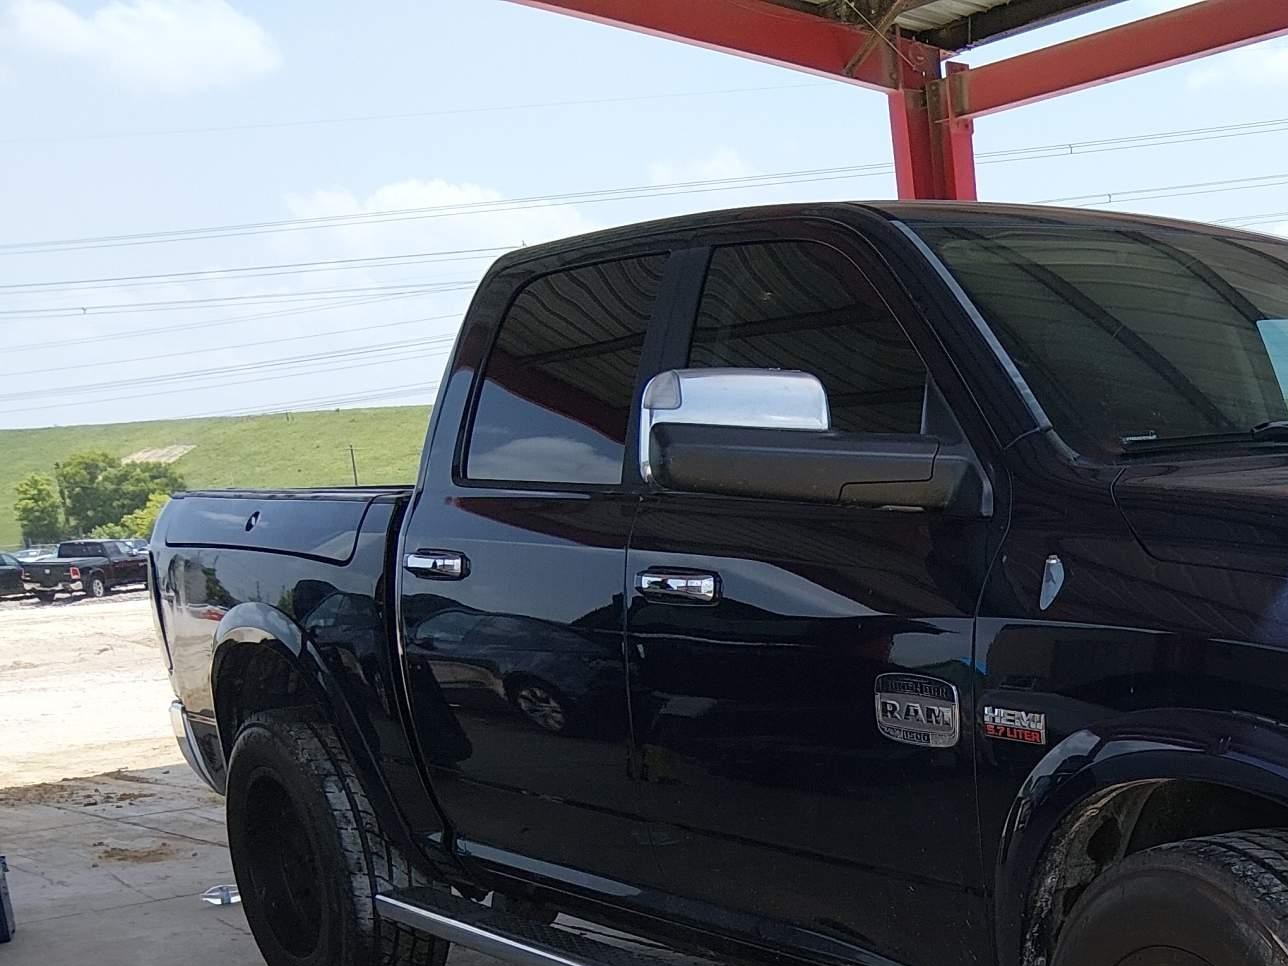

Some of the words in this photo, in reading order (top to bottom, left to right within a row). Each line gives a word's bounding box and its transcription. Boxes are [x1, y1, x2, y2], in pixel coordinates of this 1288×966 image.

[881, 699, 952, 727] RAM
[984, 706, 1045, 730] HEMI
[903, 730, 930, 743] 1500
[986, 724, 1005, 736] 5.7
[1006, 727, 1040, 742] LITER
